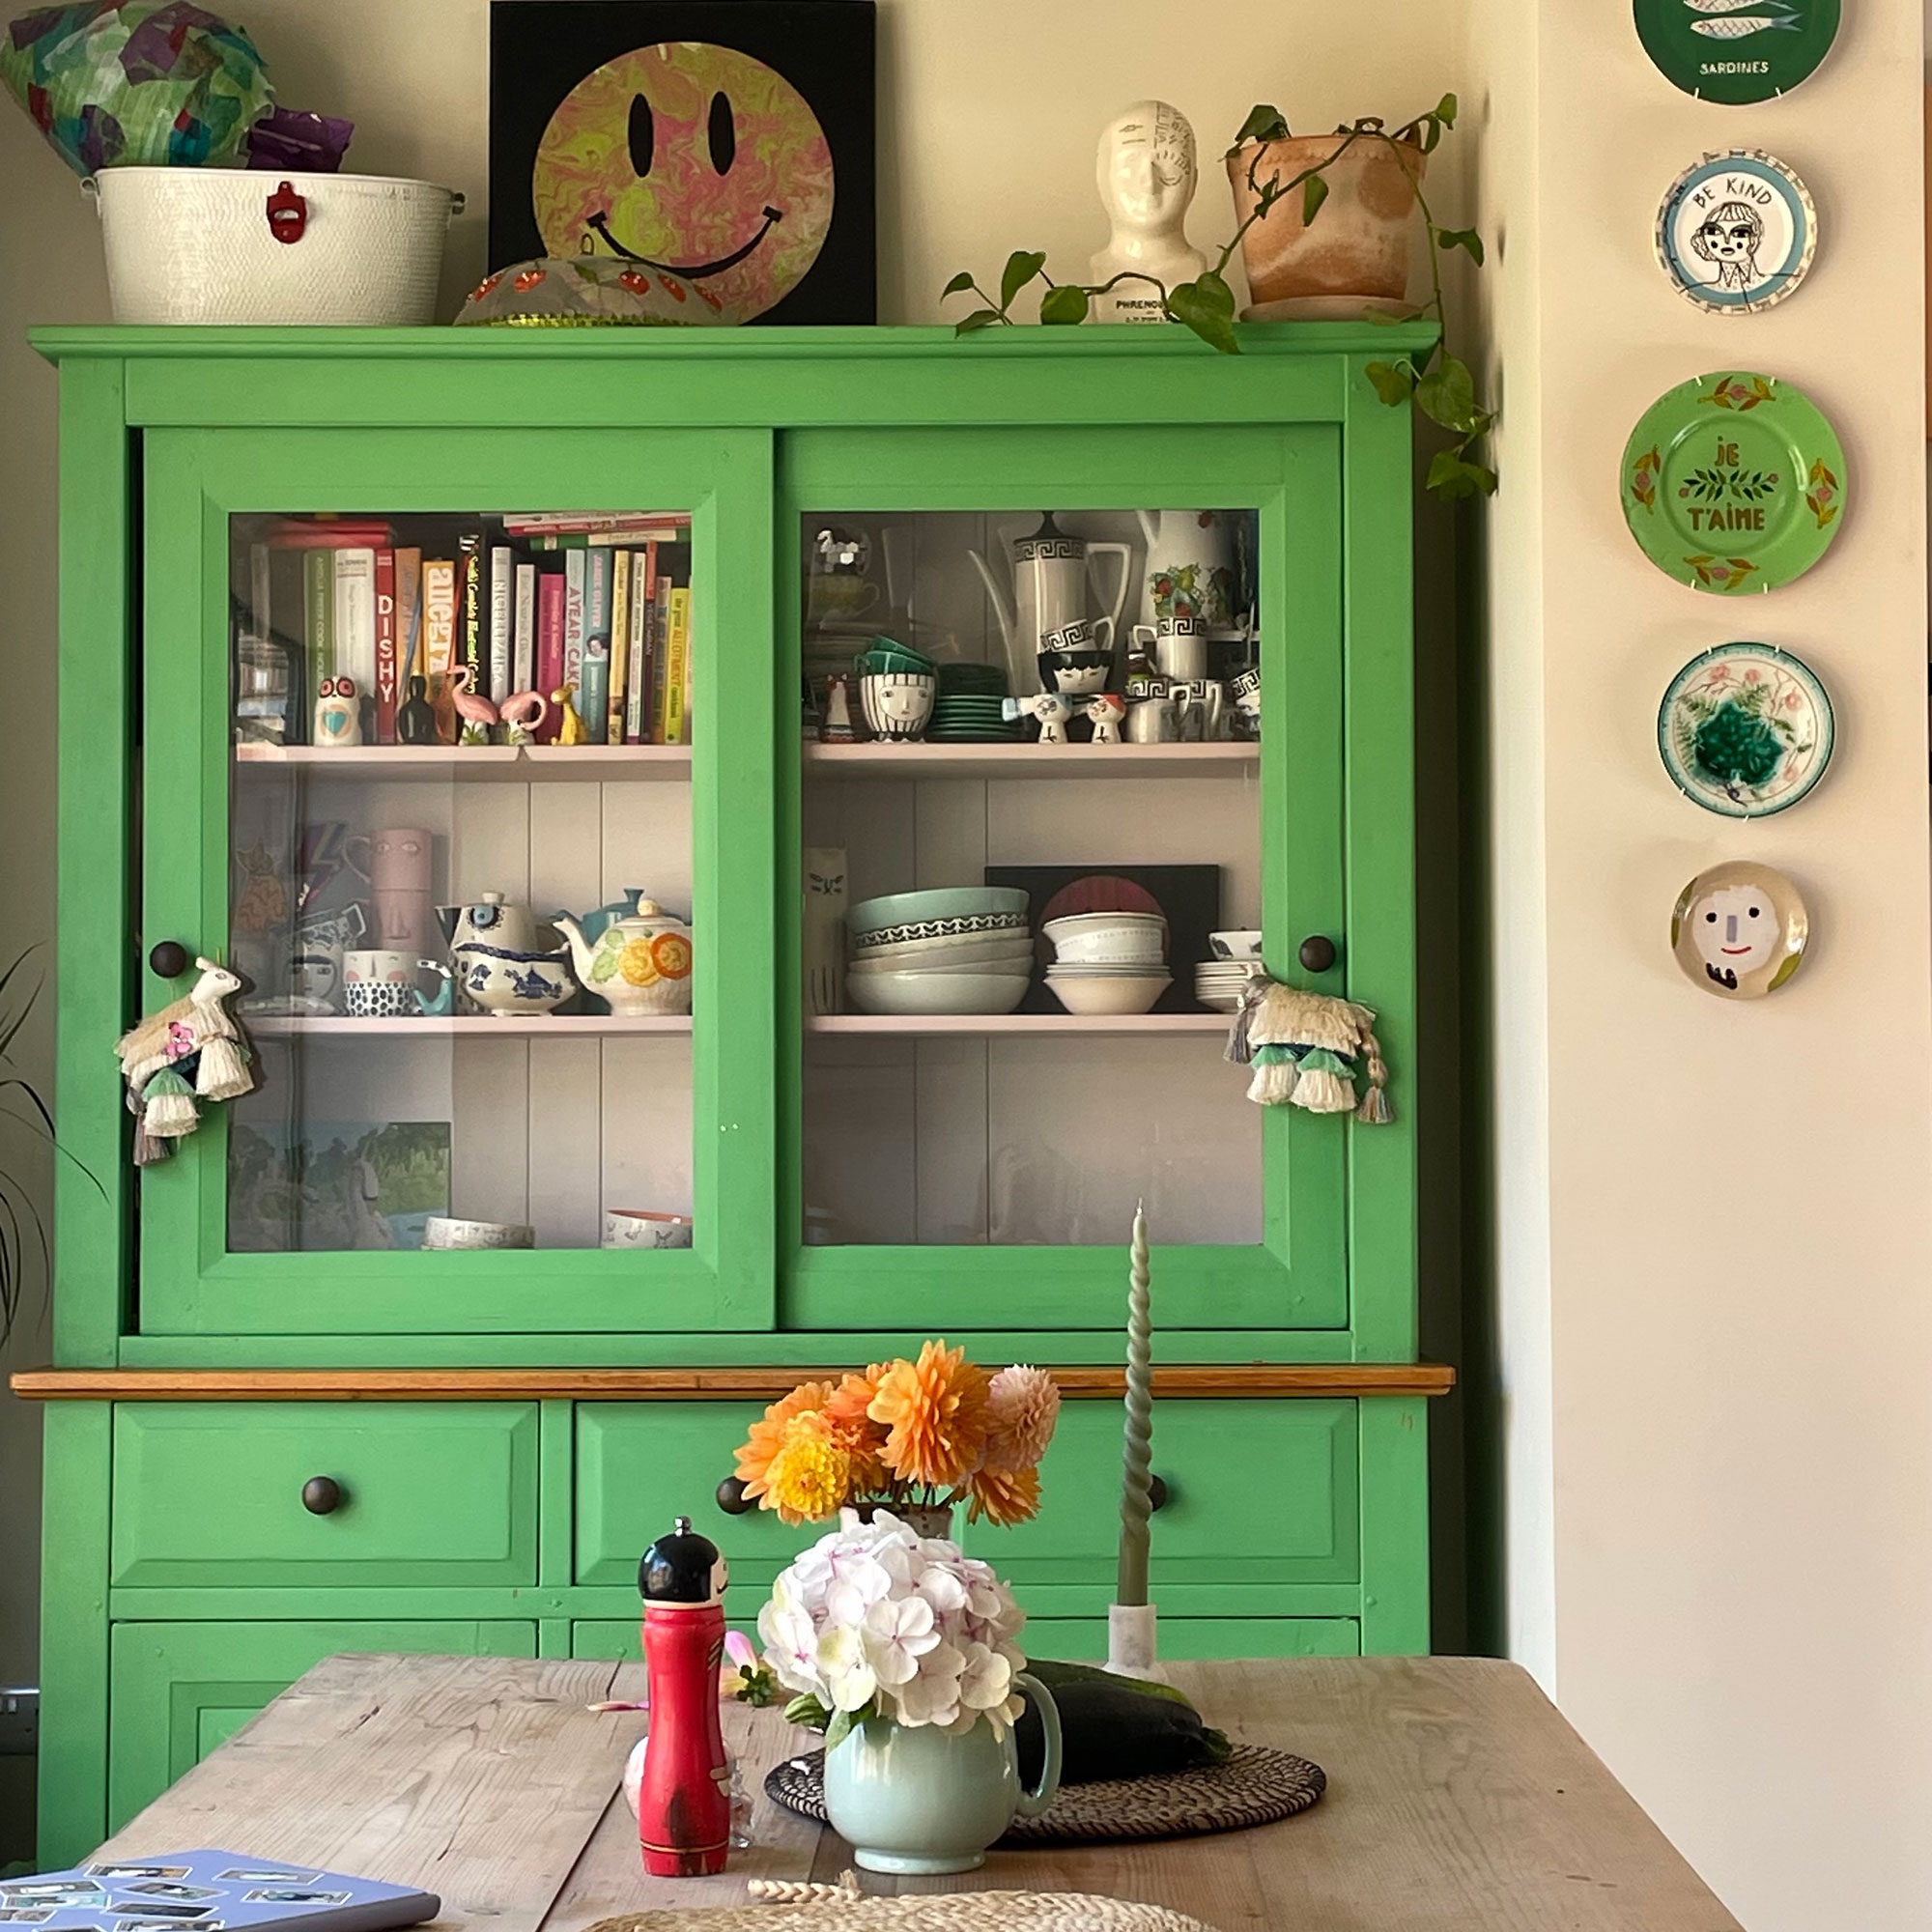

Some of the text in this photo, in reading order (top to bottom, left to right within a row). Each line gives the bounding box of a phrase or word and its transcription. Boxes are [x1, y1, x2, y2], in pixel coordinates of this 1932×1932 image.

[1699, 61, 1770, 75] SARDINES
[1692, 178, 1773, 209] BE KIND
[591, 554, 604, 628] JAMIE OLIVER
[378, 595, 394, 703] DISHY
[671, 630, 684, 687] ALLOTMENT
